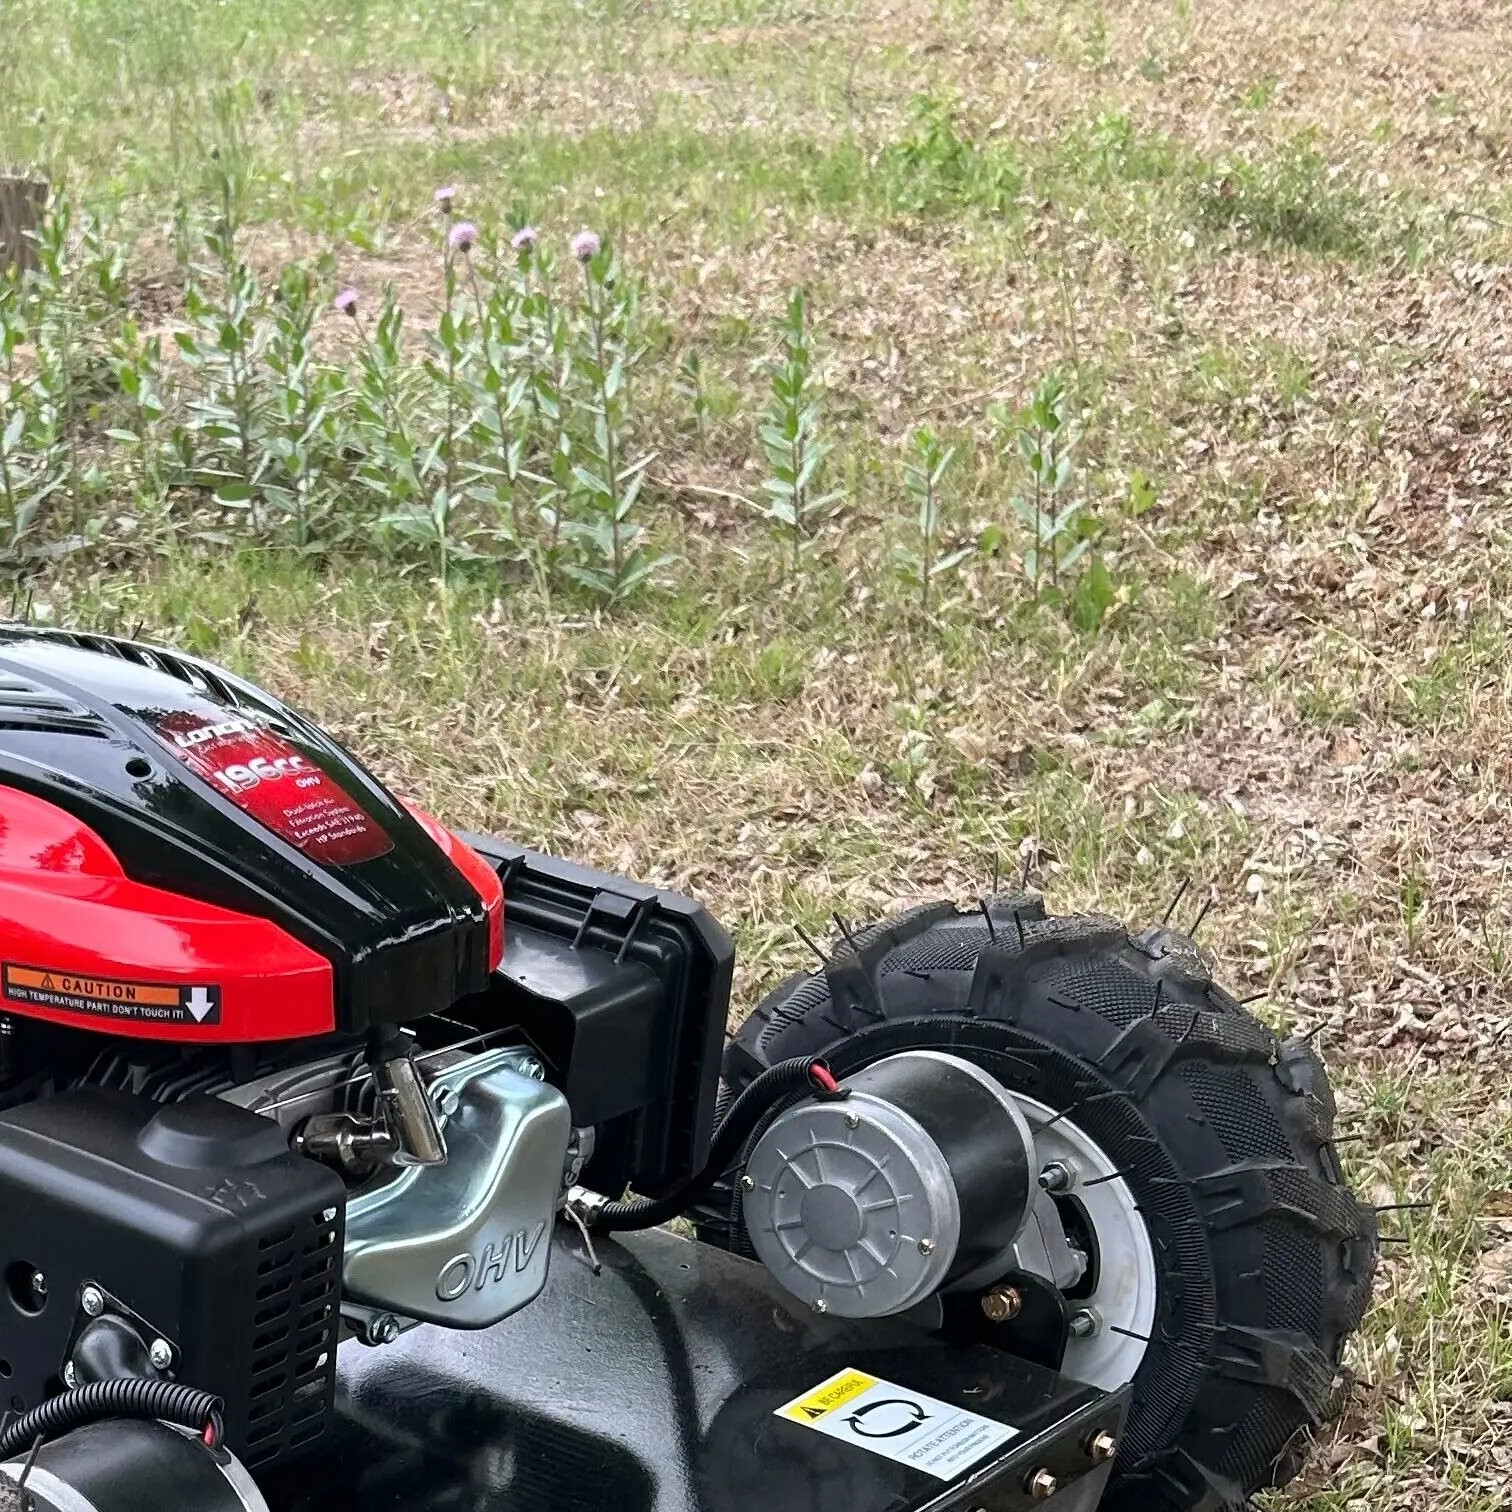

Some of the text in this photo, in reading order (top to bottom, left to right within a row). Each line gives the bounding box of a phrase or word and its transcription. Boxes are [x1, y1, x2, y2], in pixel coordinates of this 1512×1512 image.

[8, 987, 27, 999] HIGH
[30, 991, 85, 1009] TEMPERATURE
[112, 1004, 137, 1015] DON'T
[140, 1007, 169, 1018] TOUCH
[62, 978, 136, 999] CAUTION
[435, 1222, 545, 1302] OHV
[908, 1440, 939, 1460] ROTATE
[938, 1417, 975, 1443] ATTENTION
